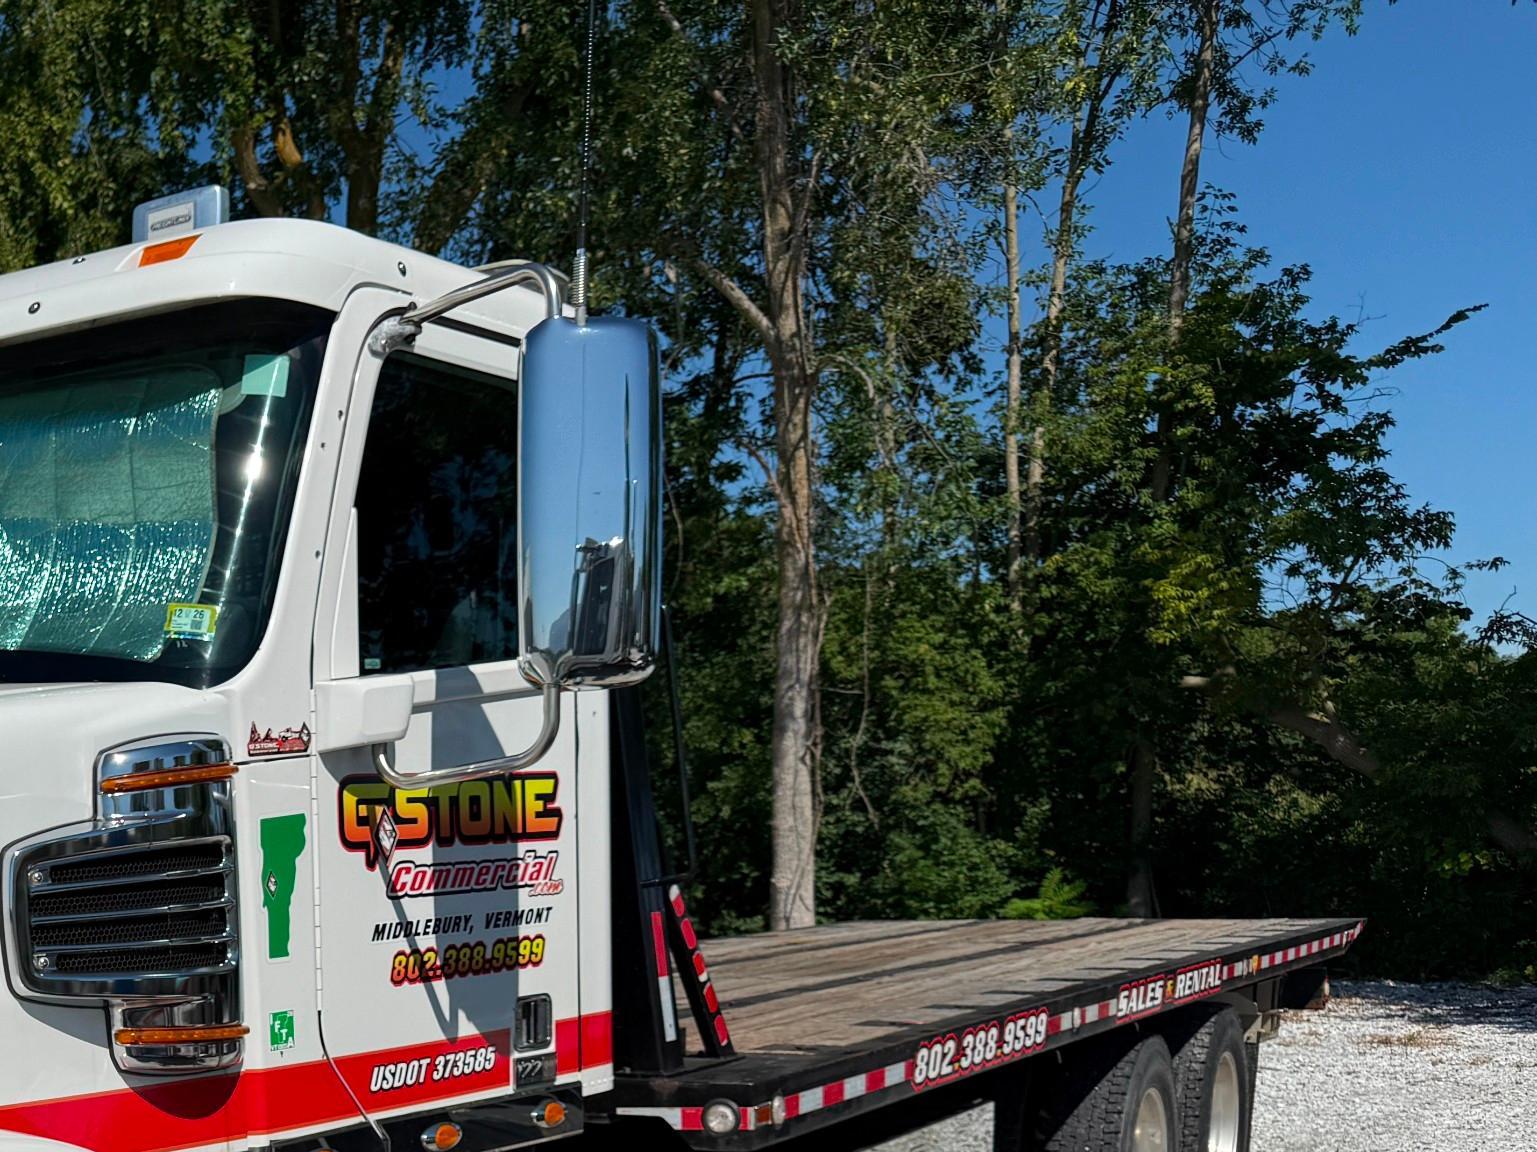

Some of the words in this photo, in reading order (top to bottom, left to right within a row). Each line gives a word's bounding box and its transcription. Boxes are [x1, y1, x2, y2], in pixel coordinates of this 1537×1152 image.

[391, 852, 557, 895] Commercial
[372, 914, 474, 942] MIDDLEBURY,
[485, 907, 553, 930] VERMONT
[392, 937, 545, 983] 802.388.9599
[1117, 979, 1164, 1017] SALES
[1175, 963, 1221, 999] RENTAL
[370, 1059, 431, 1092] USDOT
[432, 1046, 496, 1081] 373585
[915, 1011, 1047, 1083] 802.388.9599
